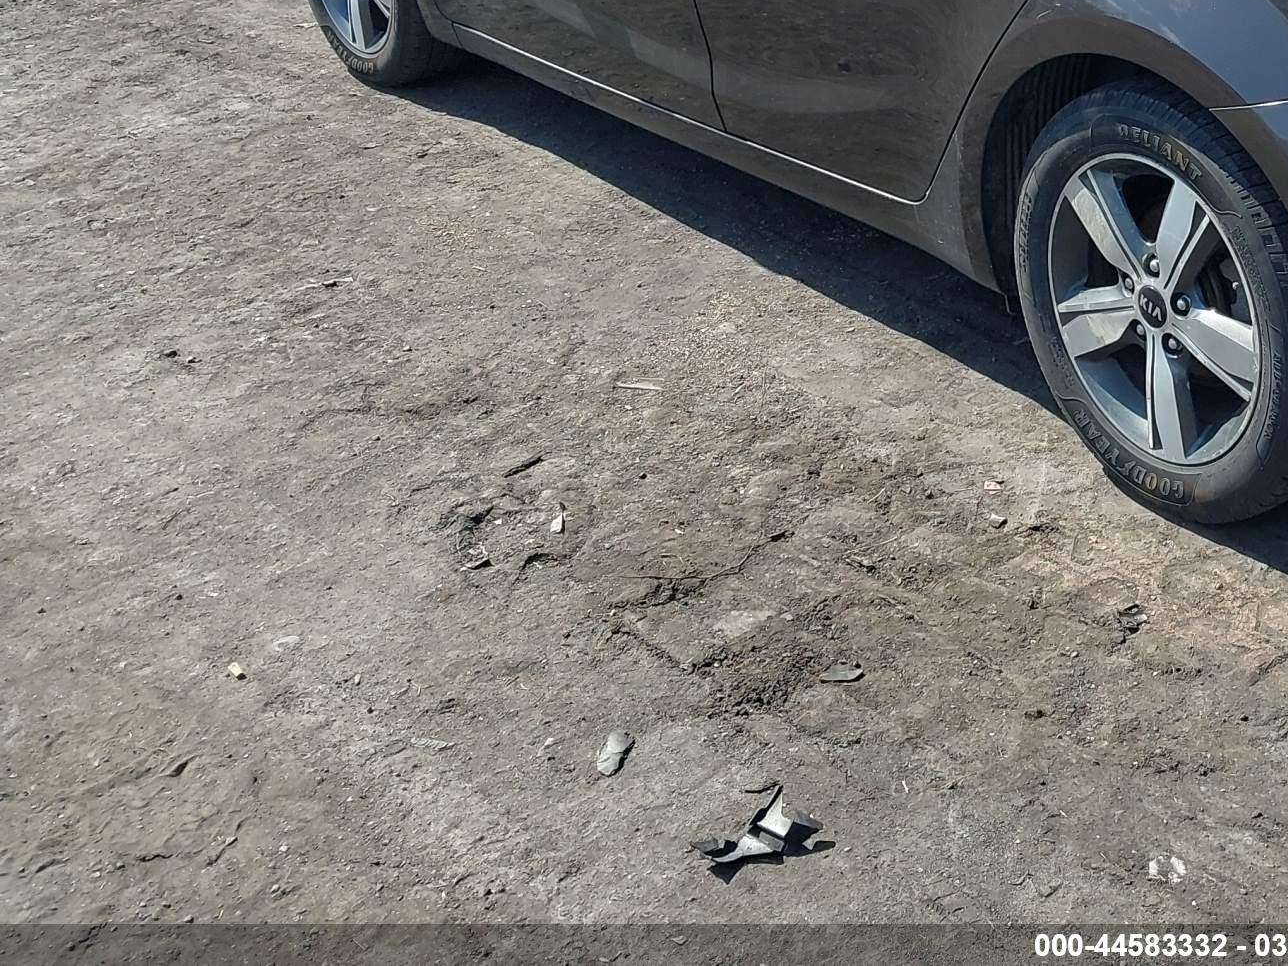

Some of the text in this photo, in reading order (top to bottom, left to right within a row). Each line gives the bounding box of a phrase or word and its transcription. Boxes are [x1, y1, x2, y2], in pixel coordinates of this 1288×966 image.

[1118, 123, 1203, 181] RELIANT
[1140, 293, 1163, 321] KIA
[1073, 408, 1185, 499] GOODYEAR
